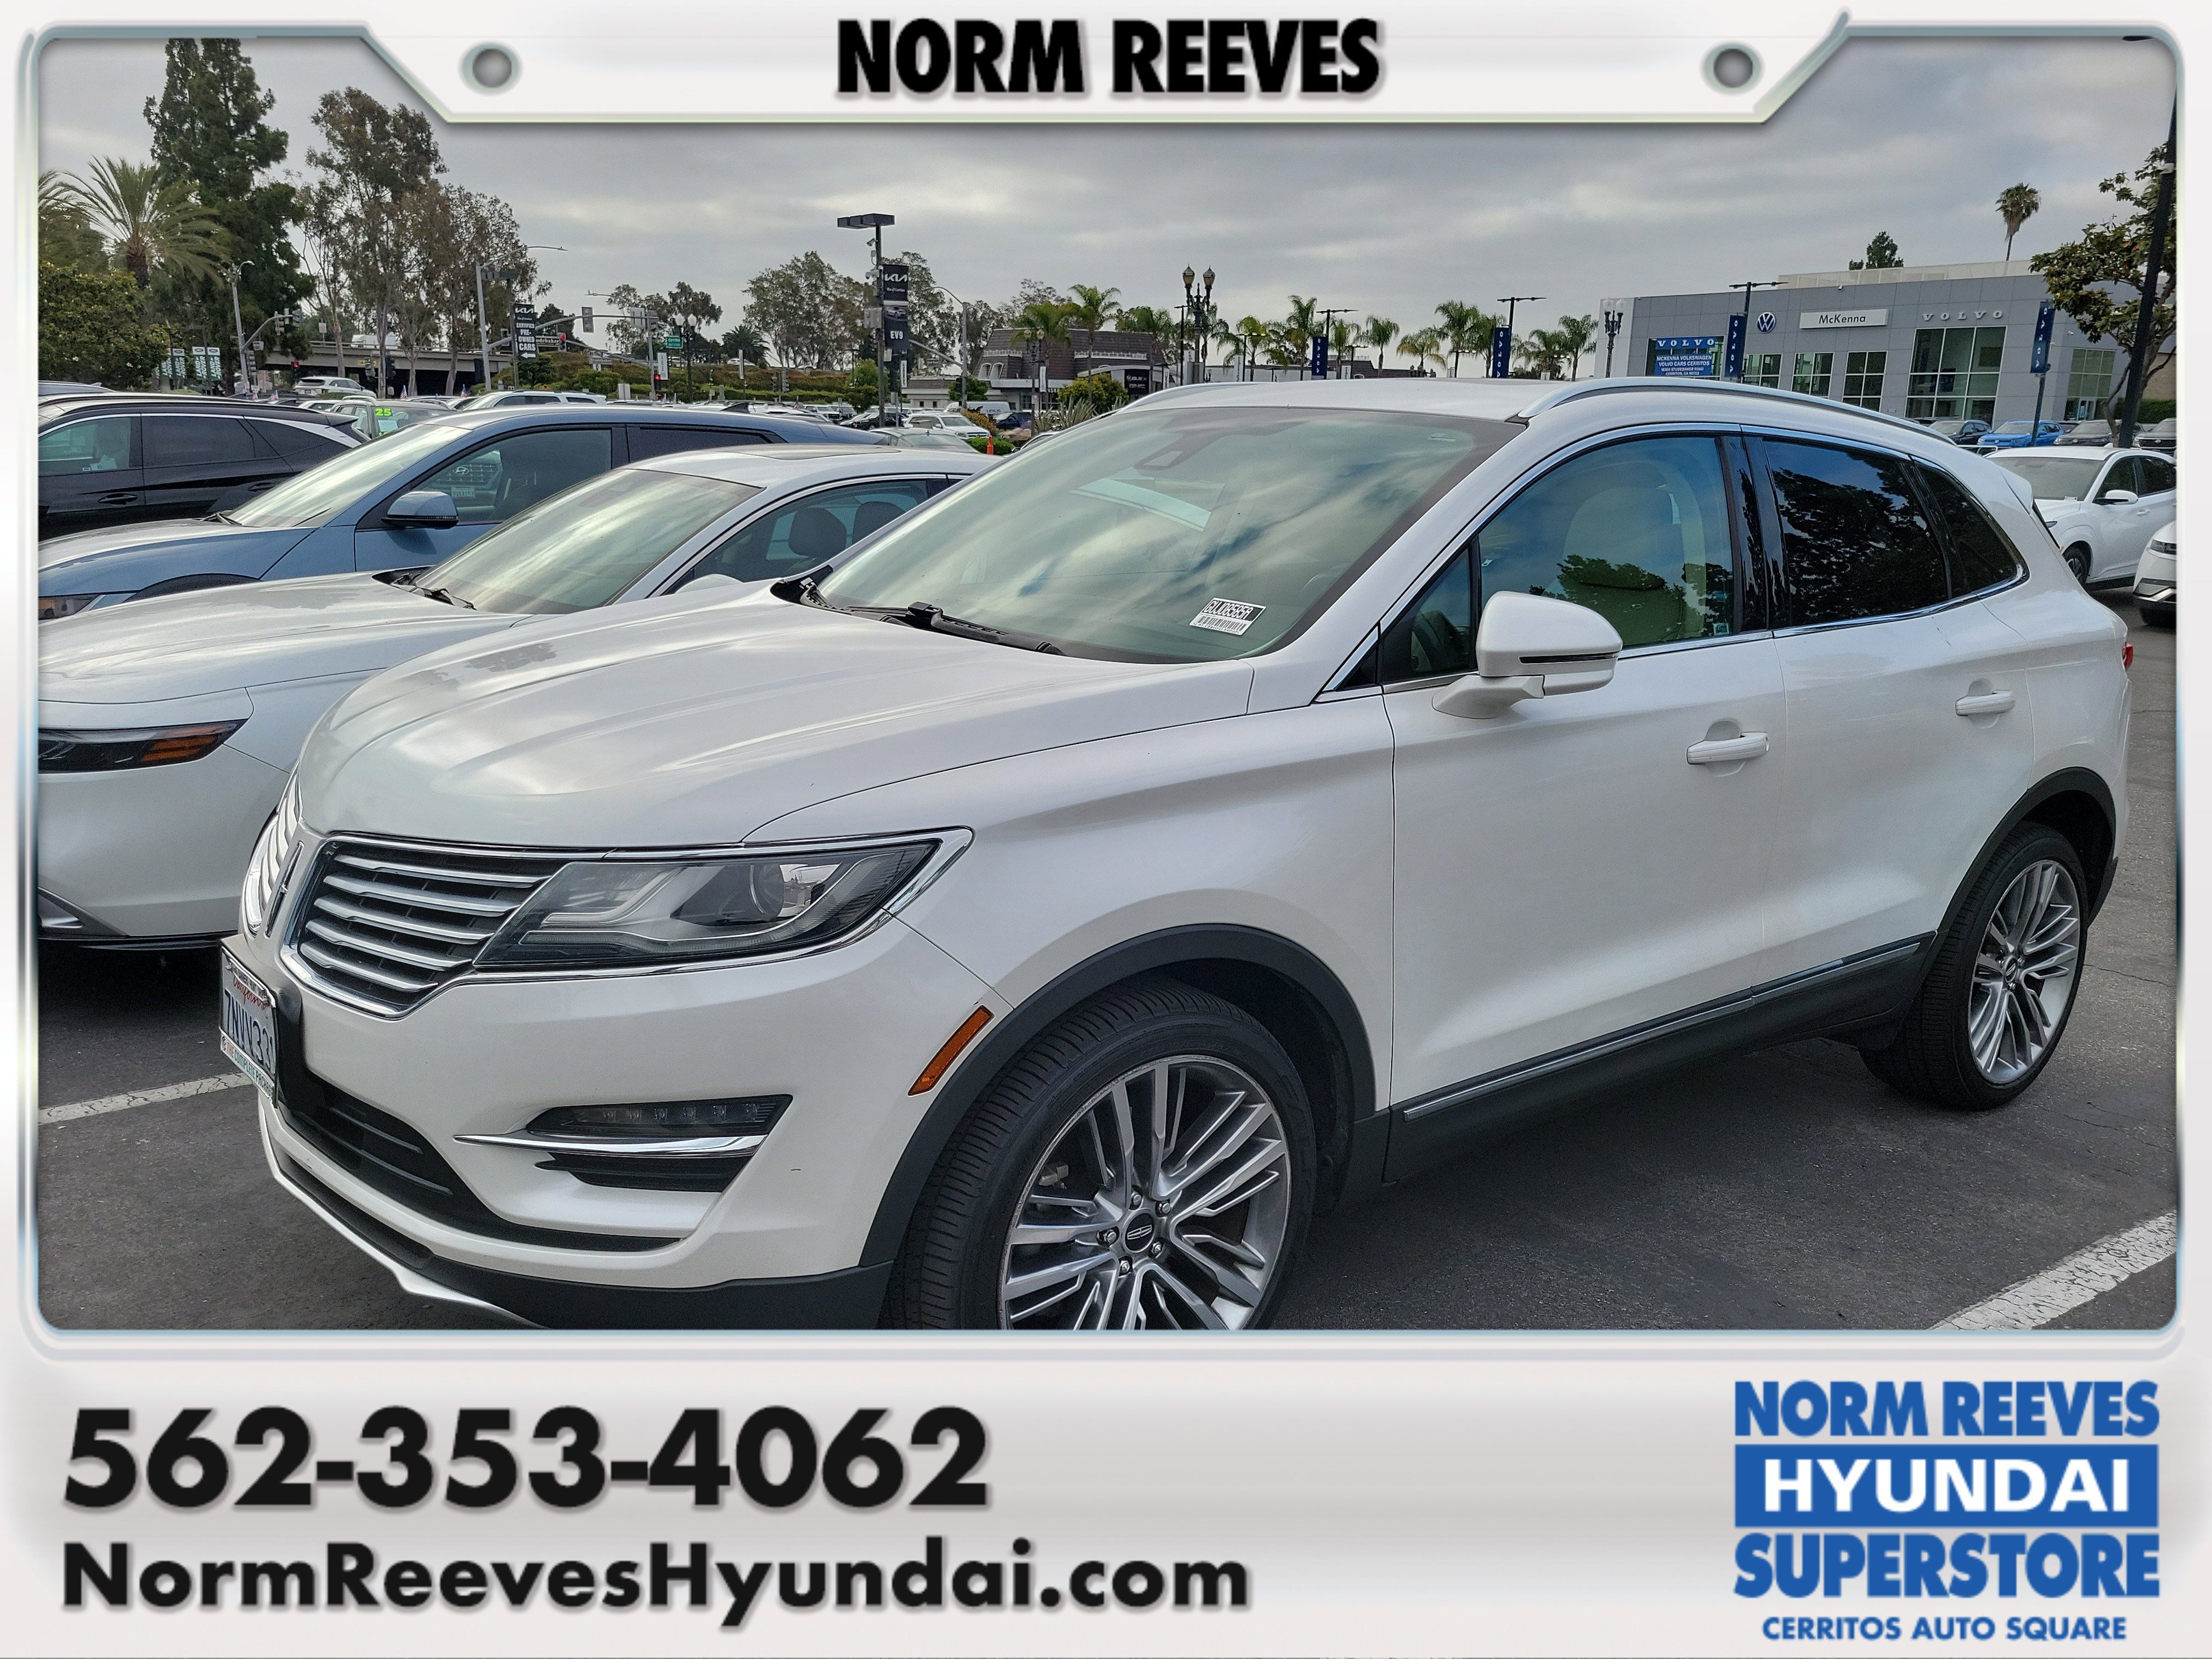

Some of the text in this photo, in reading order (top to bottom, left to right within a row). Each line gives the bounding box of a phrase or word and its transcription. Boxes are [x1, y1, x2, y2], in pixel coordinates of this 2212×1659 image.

[1819, 314, 1866, 324] McKenna
[1922, 310, 2003, 321] VOLVO
[890, 331, 904, 340] EV9
[1729, 320, 1739, 374] VOLVO
[375, 408, 392, 416] 25
[1204, 600, 1254, 620] GUJ08585A
[224, 988, 275, 1073] 7NVV33
